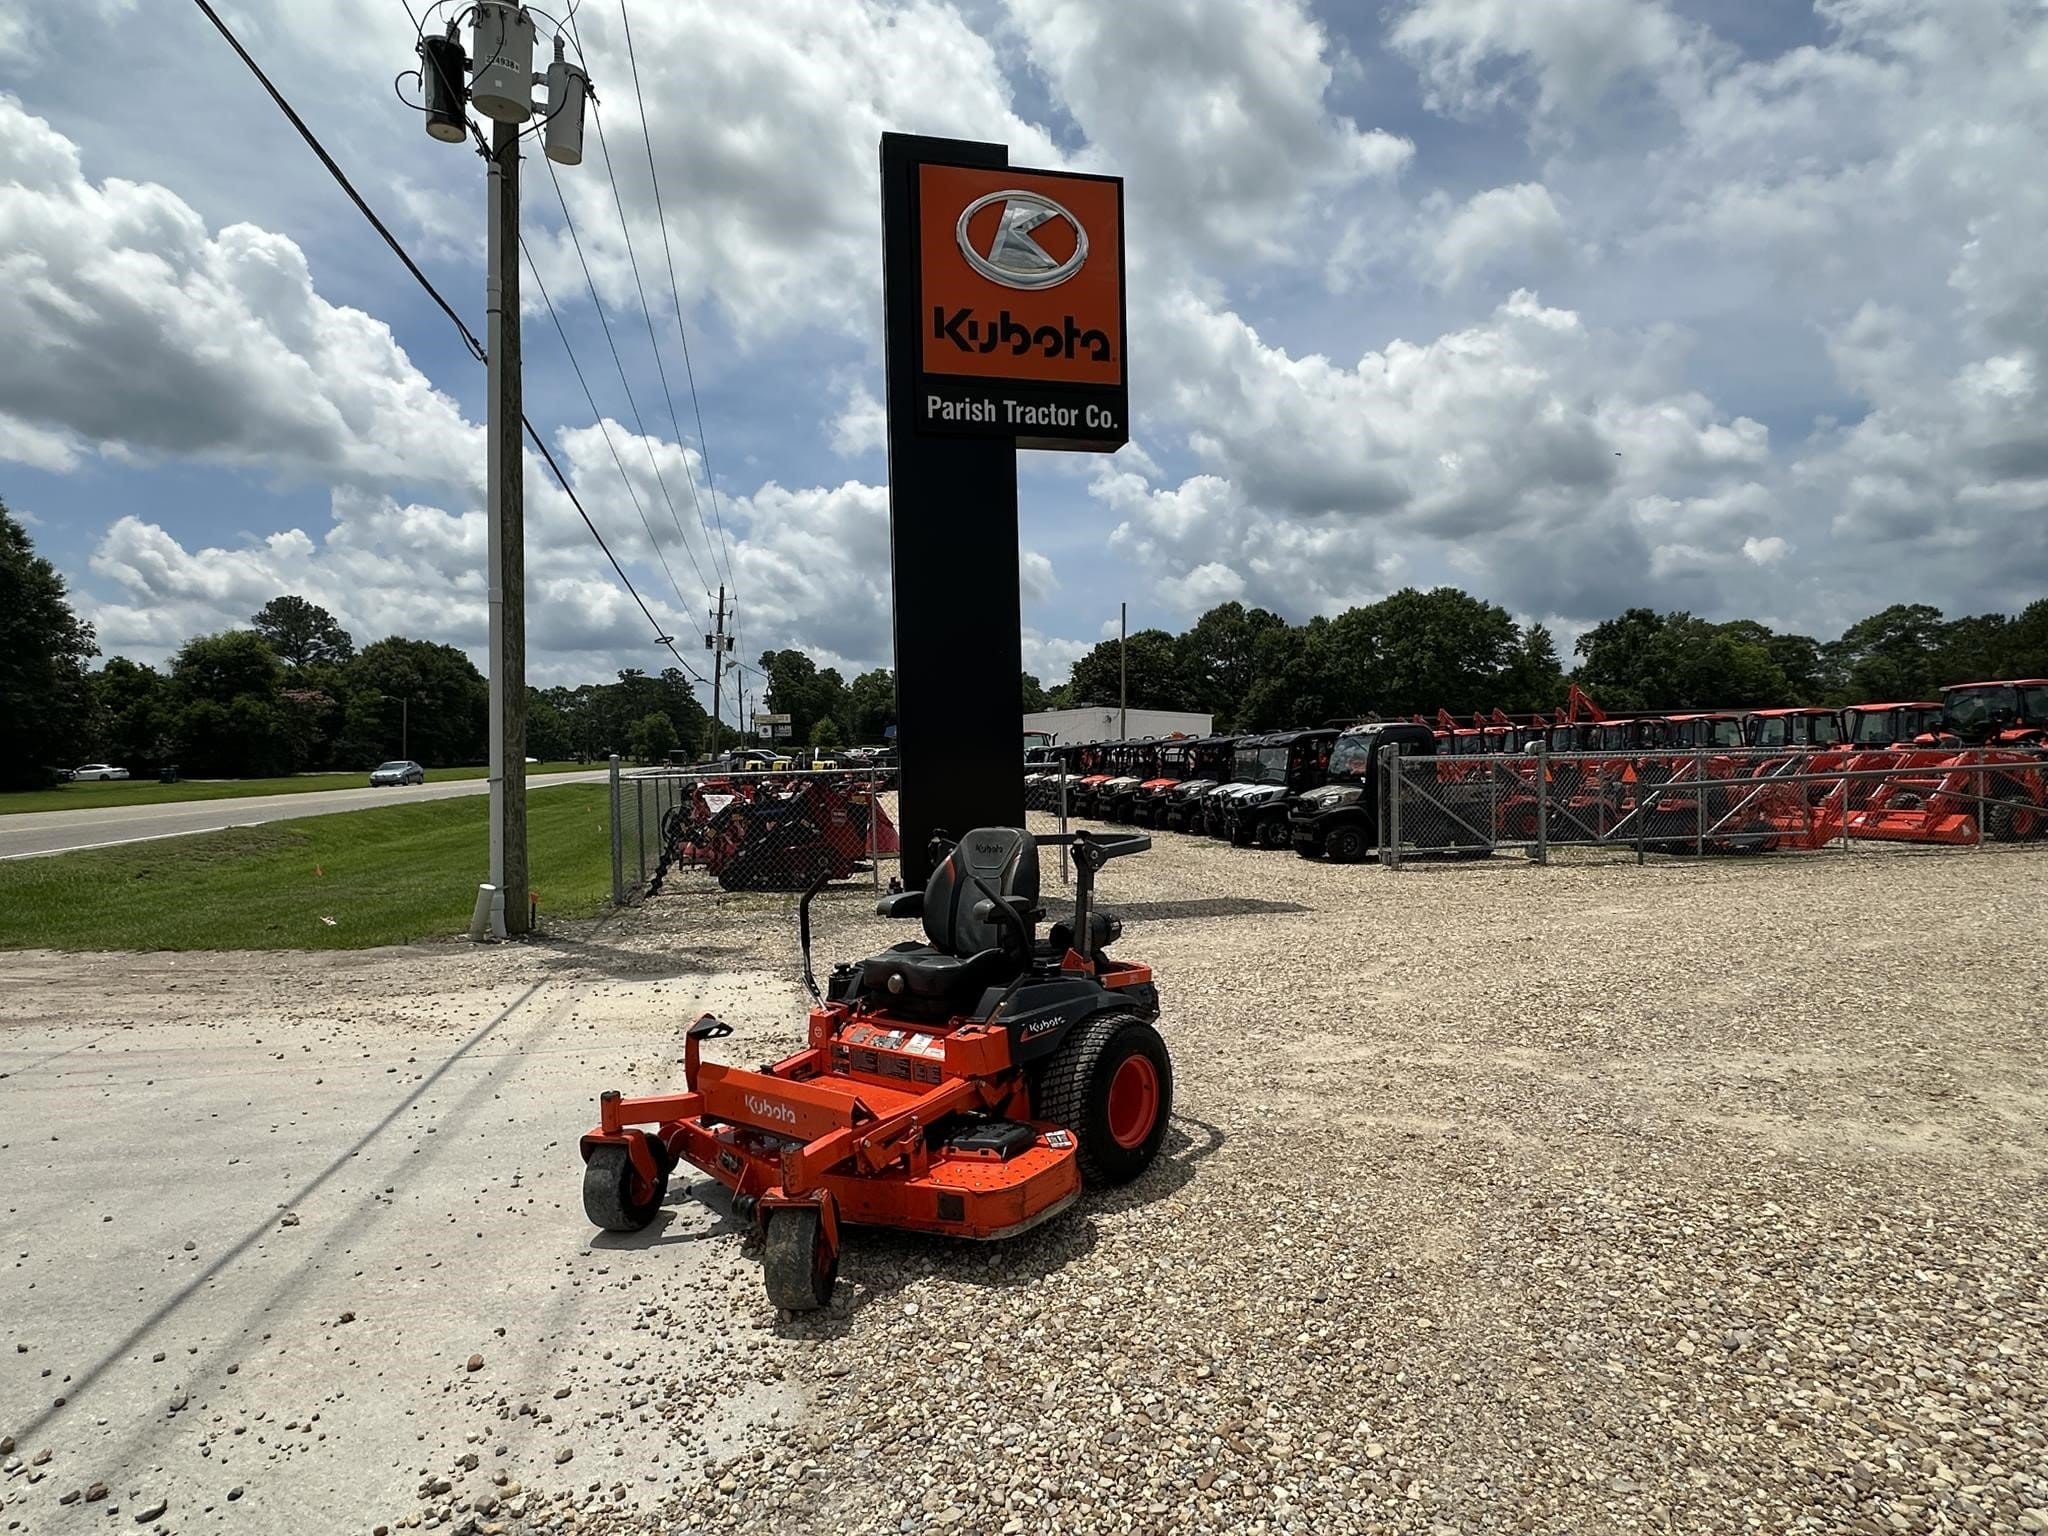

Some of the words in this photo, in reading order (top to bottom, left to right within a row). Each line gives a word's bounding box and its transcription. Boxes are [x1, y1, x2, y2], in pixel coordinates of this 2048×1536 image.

[933, 306, 1111, 362] Kubota
[927, 395, 996, 423] Parish
[1003, 399, 1079, 427] Tractor
[1085, 404, 1118, 429] Co.
[1029, 1016, 1067, 1033] Kubota
[744, 1093, 796, 1124] Kubota
